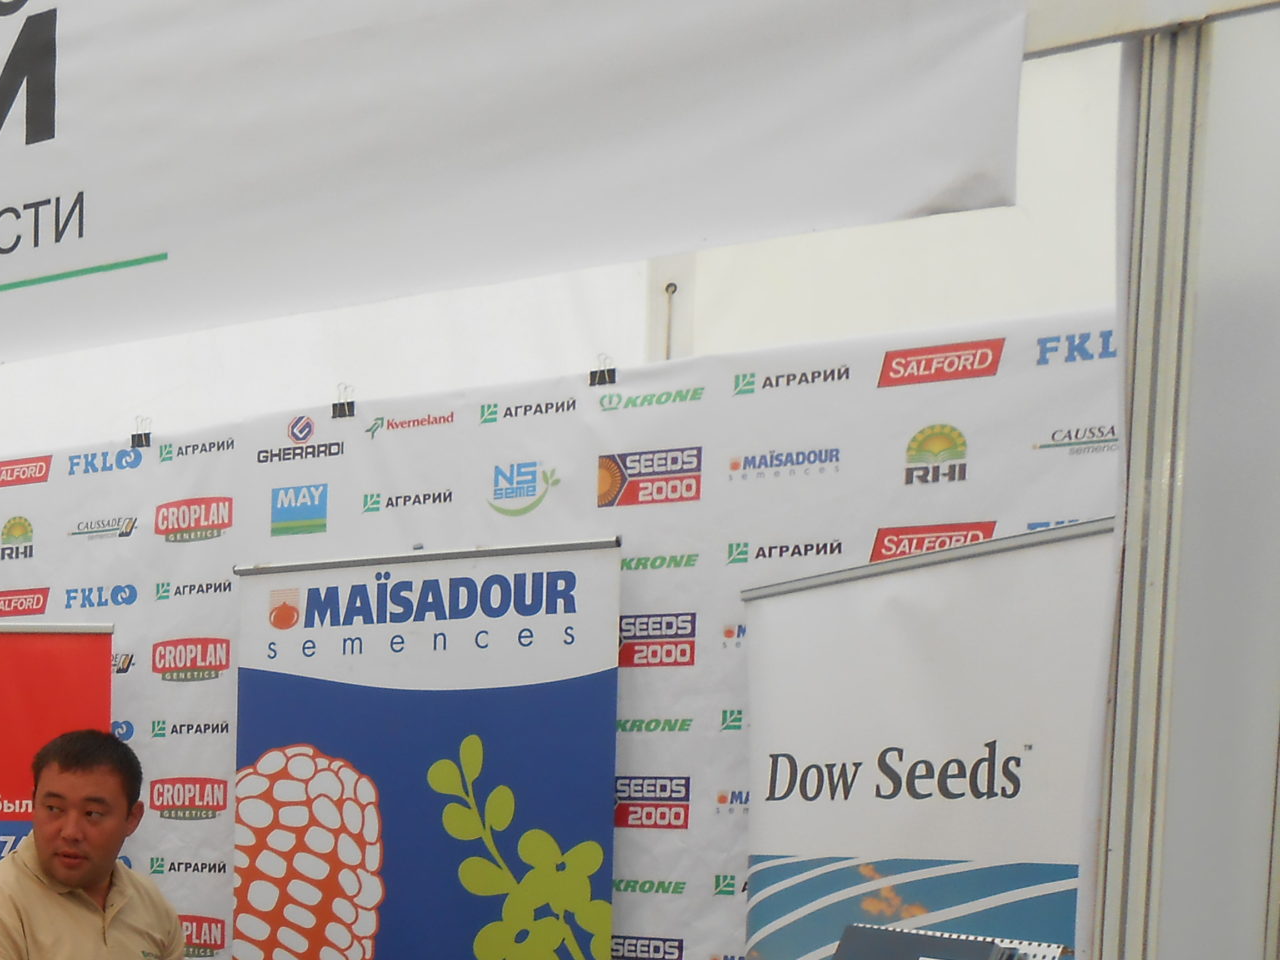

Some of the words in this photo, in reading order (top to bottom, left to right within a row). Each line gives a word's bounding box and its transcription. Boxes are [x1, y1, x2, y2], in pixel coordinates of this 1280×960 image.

[889, 348, 993, 380] SALFORD
[762, 365, 850, 390] АГРАРИЙ
[503, 398, 577, 419] АГРАРИЙ
[623, 386, 705, 410] KRONE
[386, 412, 454, 431] Kverneland
[1051, 425, 1117, 443] CAUSSA
[177, 439, 235, 457] АГРАРИЙ
[257, 441, 344, 463] GHERARDI
[68, 452, 113, 476] FKL
[626, 450, 699, 473] SEEDS
[742, 448, 840, 471] MAÏSADOUR
[494, 461, 538, 487] NS
[905, 463, 967, 486] RHI
[277, 486, 323, 509] MAY
[385, 488, 453, 508] АГРАРИЙ
[638, 478, 696, 503] 2000
[77, 517, 122, 531] CAUSSADE
[157, 501, 229, 530] CROPLAN
[168, 529, 219, 542] GENETICS
[0, 545, 33, 560] RHI
[755, 539, 842, 560] АГРАРИЙ
[621, 553, 699, 571] KRONE
[65, 586, 109, 609] FKL
[174, 581, 232, 597] АГРАРИЙ
[304, 569, 577, 629] MAÏSADOUR
[621, 616, 691, 637] SEEDS
[267, 623, 575, 659] semences
[155, 642, 226, 670] CROPLAN
[634, 644, 691, 664] 2000
[164, 670, 219, 681] GENETICS
[170, 720, 230, 737] АГРАРИЙ
[766, 752, 862, 802] Dow
[875, 740, 1022, 800] Seeds
[153, 783, 225, 808] CROPLAN
[616, 780, 686, 798] SEEDS
[163, 809, 213, 819] GENETICS
[628, 807, 684, 825] 2000
[168, 859, 227, 875] АГРАРИЙ
[611, 939, 679, 960] SEEDS
